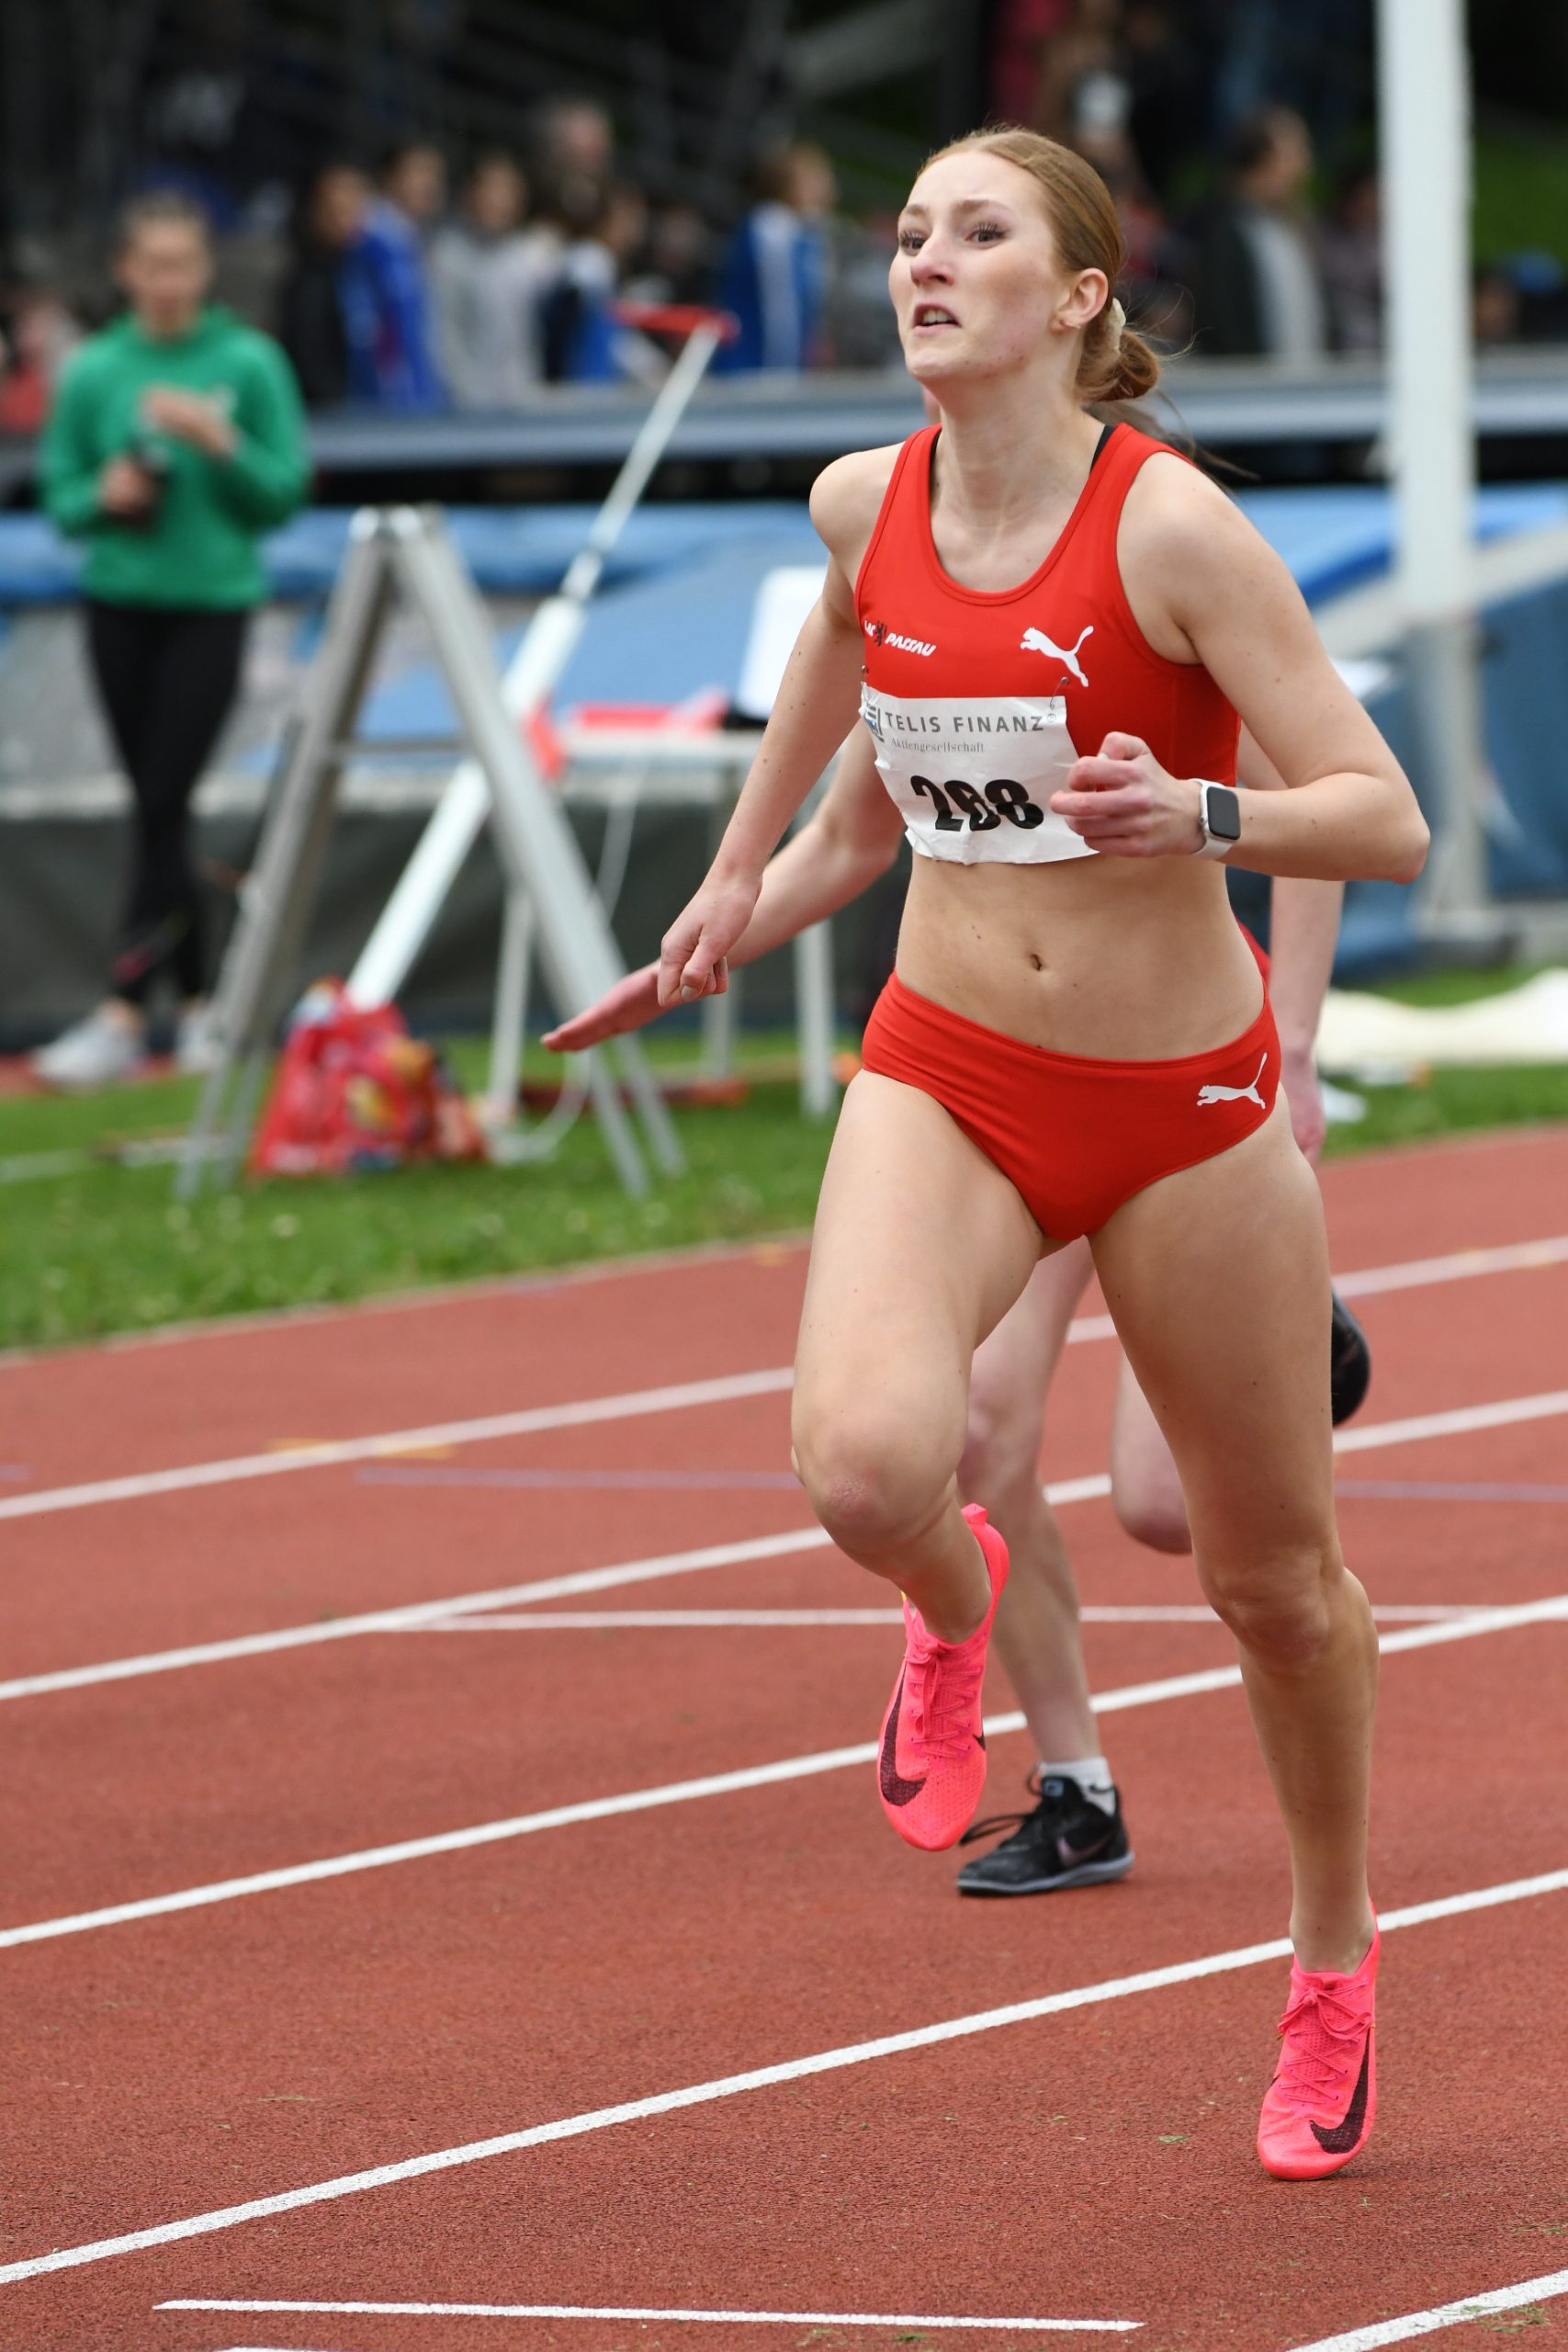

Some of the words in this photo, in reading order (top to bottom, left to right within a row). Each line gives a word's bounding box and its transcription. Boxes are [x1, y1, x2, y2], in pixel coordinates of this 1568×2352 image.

[885, 632, 936, 657] PASSAU
[885, 711, 942, 733] TELIS
[953, 716, 1044, 733] FINANZ
[891, 737, 985, 753] Aktiengesellschaft
